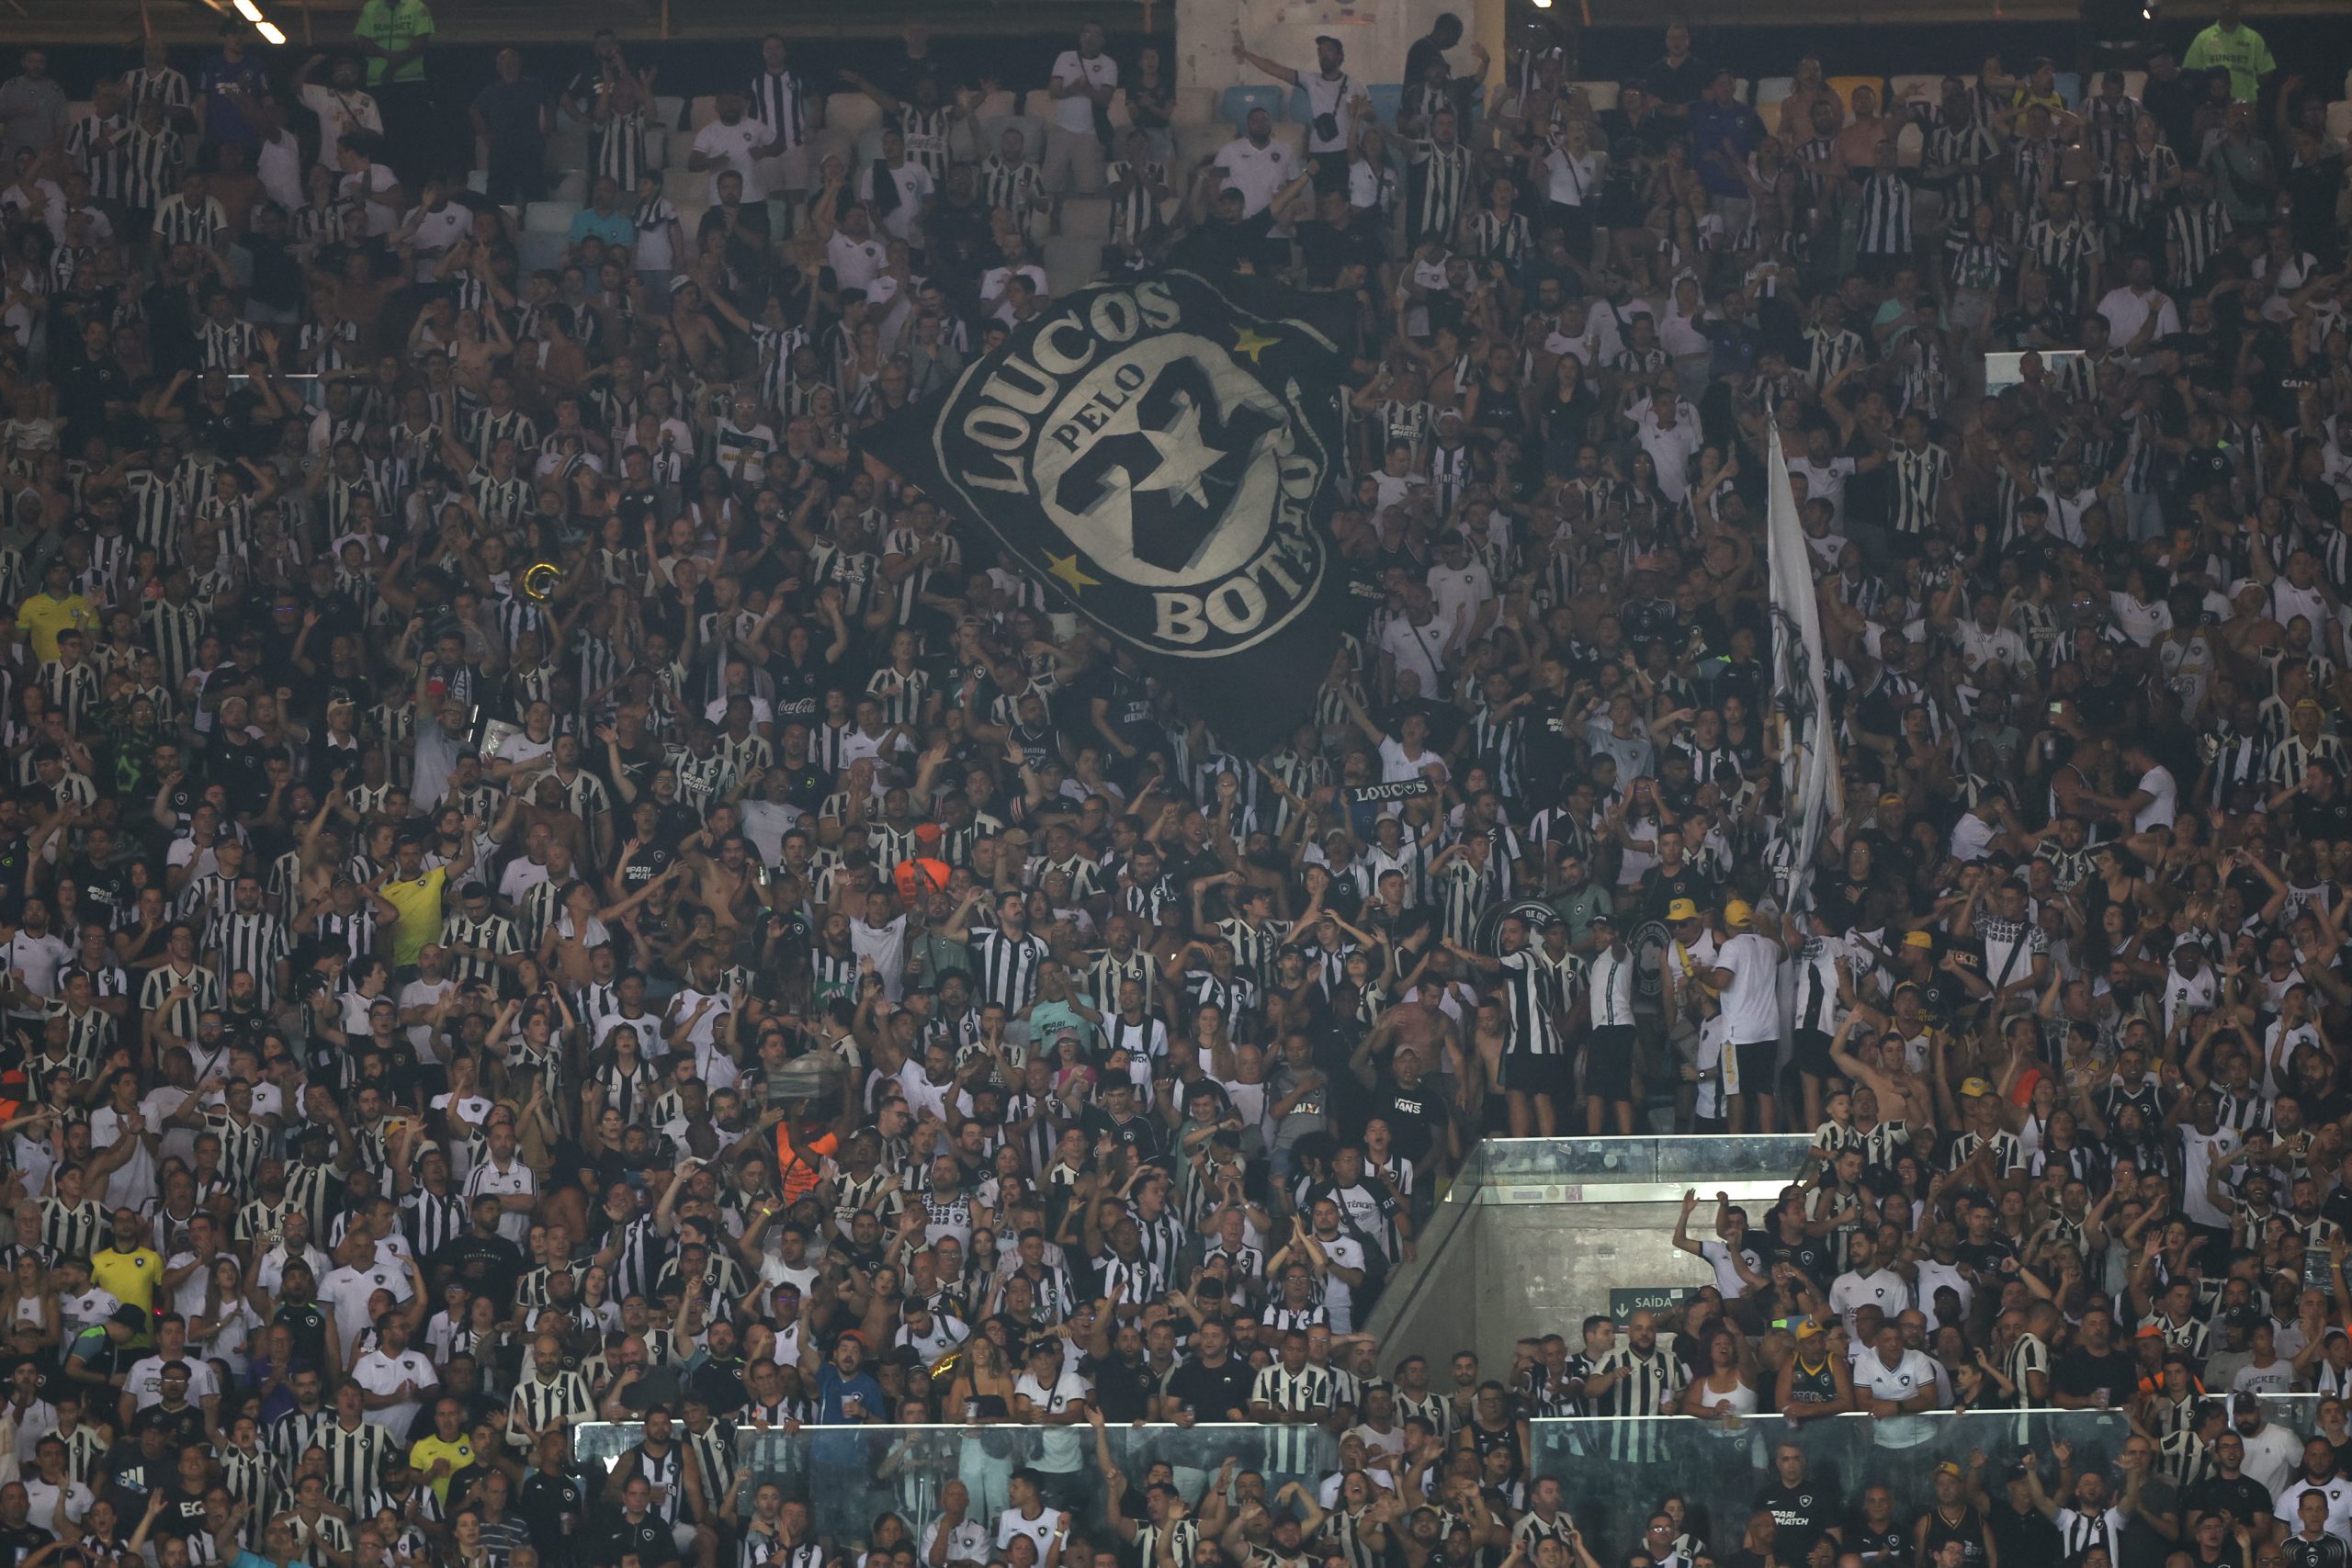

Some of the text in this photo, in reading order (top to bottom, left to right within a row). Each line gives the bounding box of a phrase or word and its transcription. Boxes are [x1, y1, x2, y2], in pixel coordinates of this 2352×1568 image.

[963, 281, 1181, 495] LOUCOS
[1051, 364, 1146, 454] PELO
[681, 771, 707, 786] PARI
[681, 778, 715, 795] MATCH
[626, 865, 652, 874] PARI
[1395, 1097, 1423, 1115] VANS
[1634, 1295, 1673, 1308] SAÍDA
[1771, 1510, 1797, 1519] PARI
[1775, 1517, 1809, 1527] MATCH
